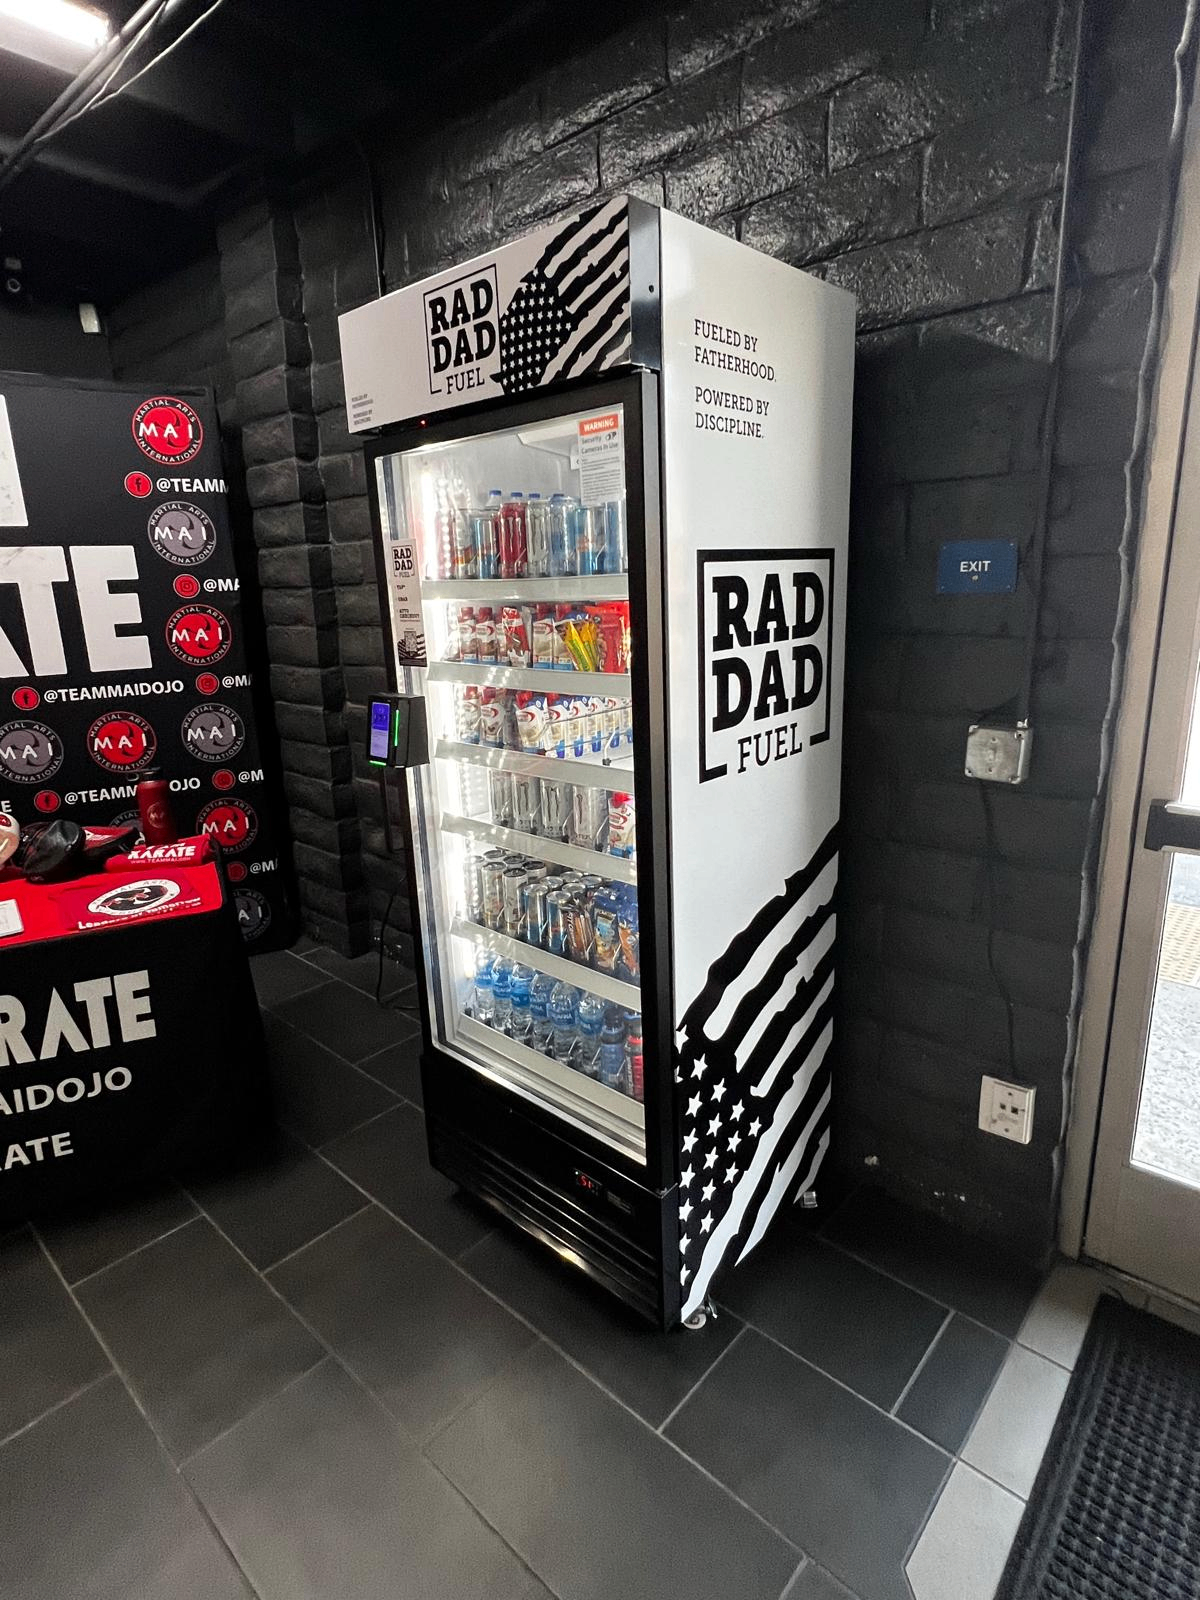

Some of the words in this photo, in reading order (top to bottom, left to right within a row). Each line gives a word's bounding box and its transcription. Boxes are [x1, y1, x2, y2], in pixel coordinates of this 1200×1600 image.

[428, 278, 494, 335] RAD
[431, 320, 497, 374] DAD
[694, 318, 741, 347] FUELED
[743, 334, 759, 353] BY
[694, 345, 777, 383] FATHERHOOD.
[446, 366, 486, 395] FUEL
[135, 399, 170, 423] MARTIAL
[175, 403, 197, 423] ARTS
[695, 386, 754, 413] POWERED
[756, 400, 770, 416] BY
[138, 422, 193, 440] MAI
[583, 417, 615, 432] WARNING
[695, 412, 765, 439] DISCIPLINE.
[137, 437, 202, 463] INTERNATIONAL
[581, 444, 603, 455] Cameras
[150, 503, 183, 526] MARTIAL
[188, 506, 209, 525] ARTS
[154, 526, 207, 541] MAI
[153, 539, 216, 564] INTERNATIONAL
[393, 547, 412, 560] RAD
[394, 559, 413, 571] DAD
[959, 560, 992, 573] EXIT
[0, 544, 153, 679] TE
[168, 606, 201, 629] MARTIAL
[206, 608, 226, 626] ARTS
[712, 571, 825, 652] RAD
[171, 626, 223, 643] MAI
[170, 639, 231, 664] INTERNATIONAL
[43, 679, 184, 704] @TEAMMAIDOJO
[222, 674, 252, 689] @M
[712, 643, 824, 733] DAD
[90, 713, 122, 737] MARTIAL
[128, 715, 150, 732] ARTS
[183, 705, 214, 728] MARTIAL
[219, 707, 238, 722] ARTS
[33, 723, 56, 741] ARTS
[94, 733, 147, 751] MAI
[187, 723, 236, 742] MAI
[93, 746, 156, 771] INTERNATIONAL
[186, 736, 244, 761] INTERNATIONAL
[737, 722, 803, 774] FUEL
[202, 816, 250, 836] MAI
